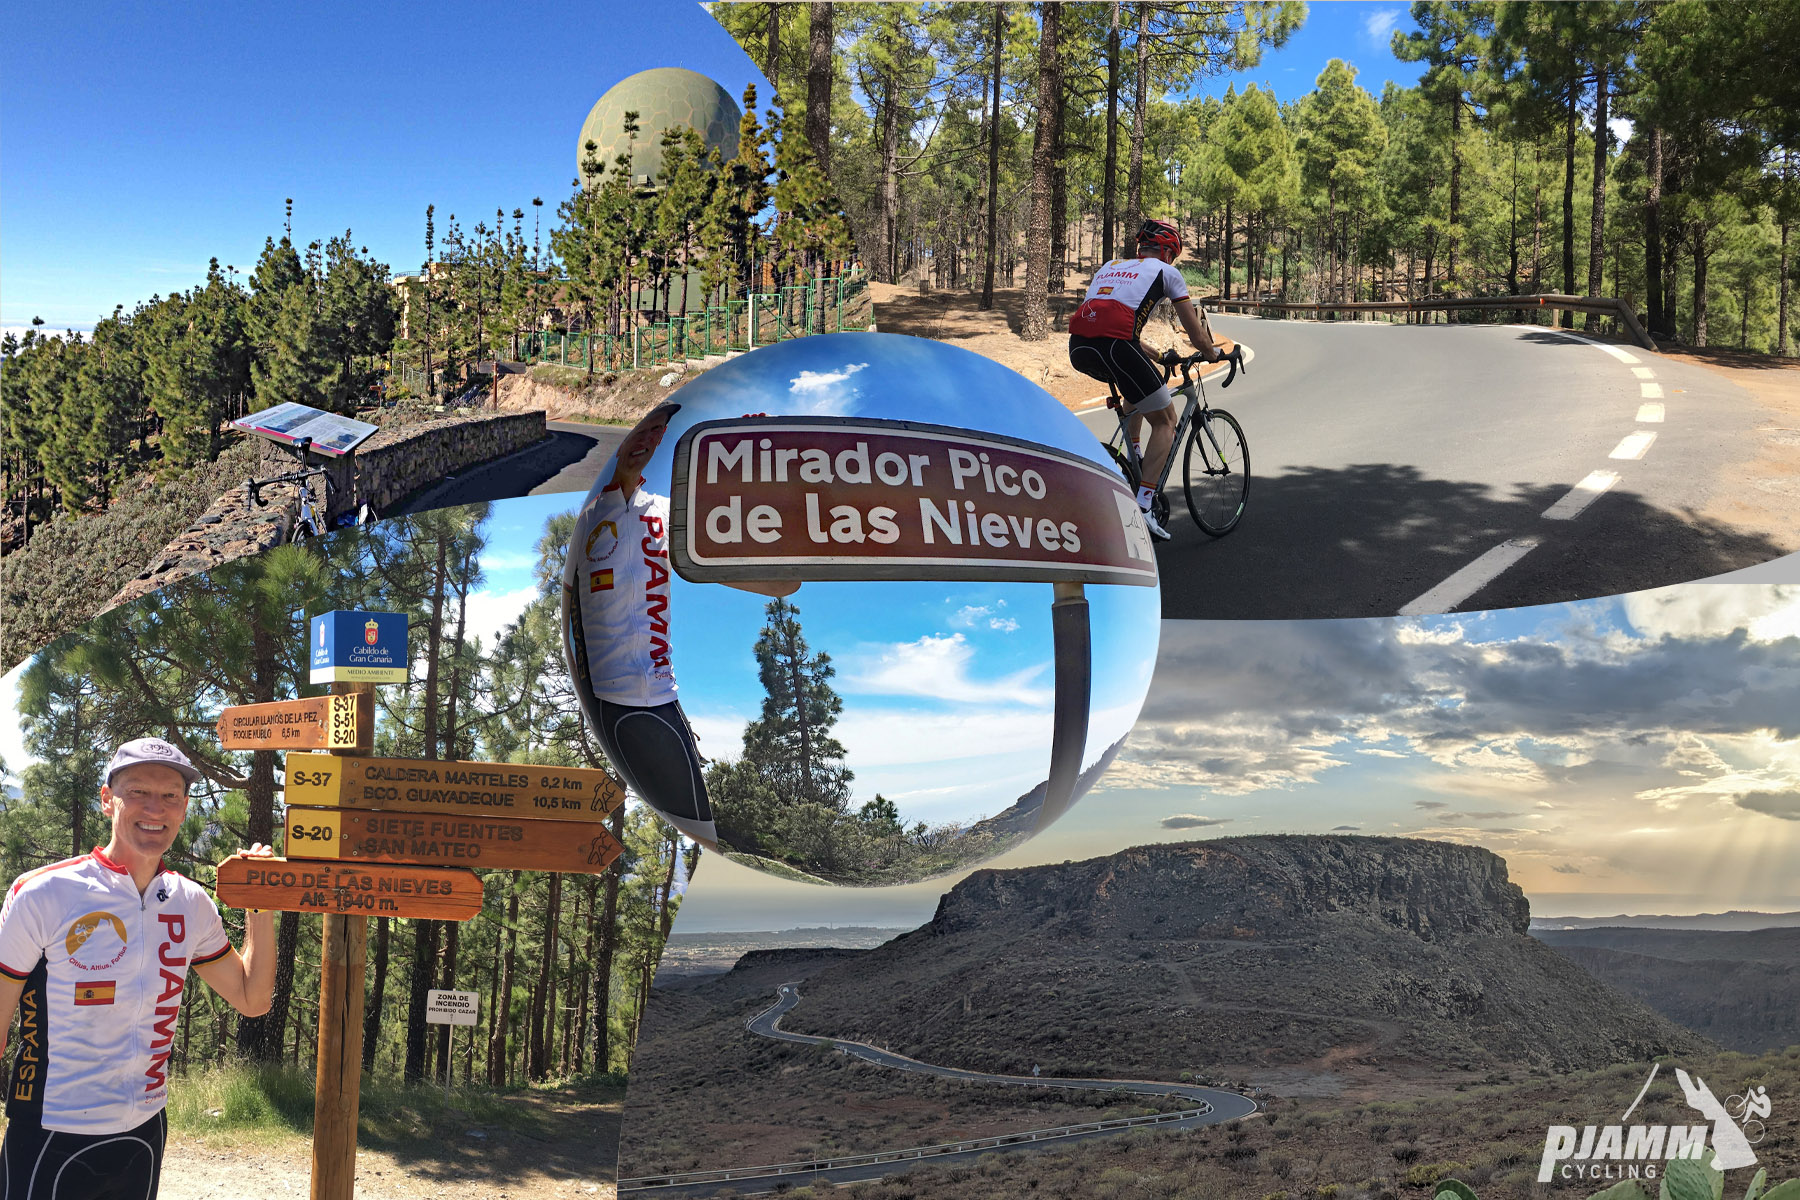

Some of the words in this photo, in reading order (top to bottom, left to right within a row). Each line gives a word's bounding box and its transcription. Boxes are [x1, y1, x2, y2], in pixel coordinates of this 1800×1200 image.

[706, 439, 931, 488] Mirador
[947, 448, 1048, 501] Pico
[705, 496, 784, 545] de
[804, 493, 900, 546] las
[918, 496, 1083, 554] Nieves
[639, 514, 670, 668] PJAMM
[349, 654, 366, 663] Gran
[367, 655, 393, 663] Canaria
[353, 646, 379, 655] Cabildo
[380, 647, 389, 655] de
[334, 697, 355, 712] S-37
[233, 716, 260, 727] CIRCULAR
[260, 713, 284, 726] LLANOS
[284, 713, 294, 724] DE
[294, 712, 304, 723] LA
[303, 711, 318, 723] PEZ
[334, 713, 355, 728] S-51
[233, 730, 252, 740] ROQUE
[252, 729, 272, 740] NUBLO
[281, 728, 291, 739] 6,5
[291, 727, 300, 738] km
[334, 730, 355, 744] S-20
[293, 771, 333, 787] S-37
[364, 766, 440, 784] CALDERA
[444, 771, 529, 788] MARTELES
[540, 776, 561, 790] 6,2
[562, 777, 583, 790] km
[363, 786, 402, 801] BCO.
[406, 788, 515, 808] GUAYADEQUE
[532, 796, 560, 811] 10,5
[561, 797, 582, 810] km
[291, 825, 333, 841] S-20
[366, 819, 425, 838] SIETE
[430, 822, 524, 842] FUENTES
[364, 837, 405, 855] SAN
[410, 839, 482, 859] MATEO
[246, 869, 297, 888] PICO
[301, 873, 330, 889] DE
[334, 874, 373, 892] LAS
[378, 877, 453, 896] NIEVES
[299, 891, 329, 908] Alt.
[333, 891, 375, 911] 1940
[379, 899, 399, 911] m.
[68, 957, 88, 971] Citius,
[110, 945, 128, 965] Fortius
[144, 913, 187, 1093] PJAMM
[14, 988, 38, 1102] ESPANA
